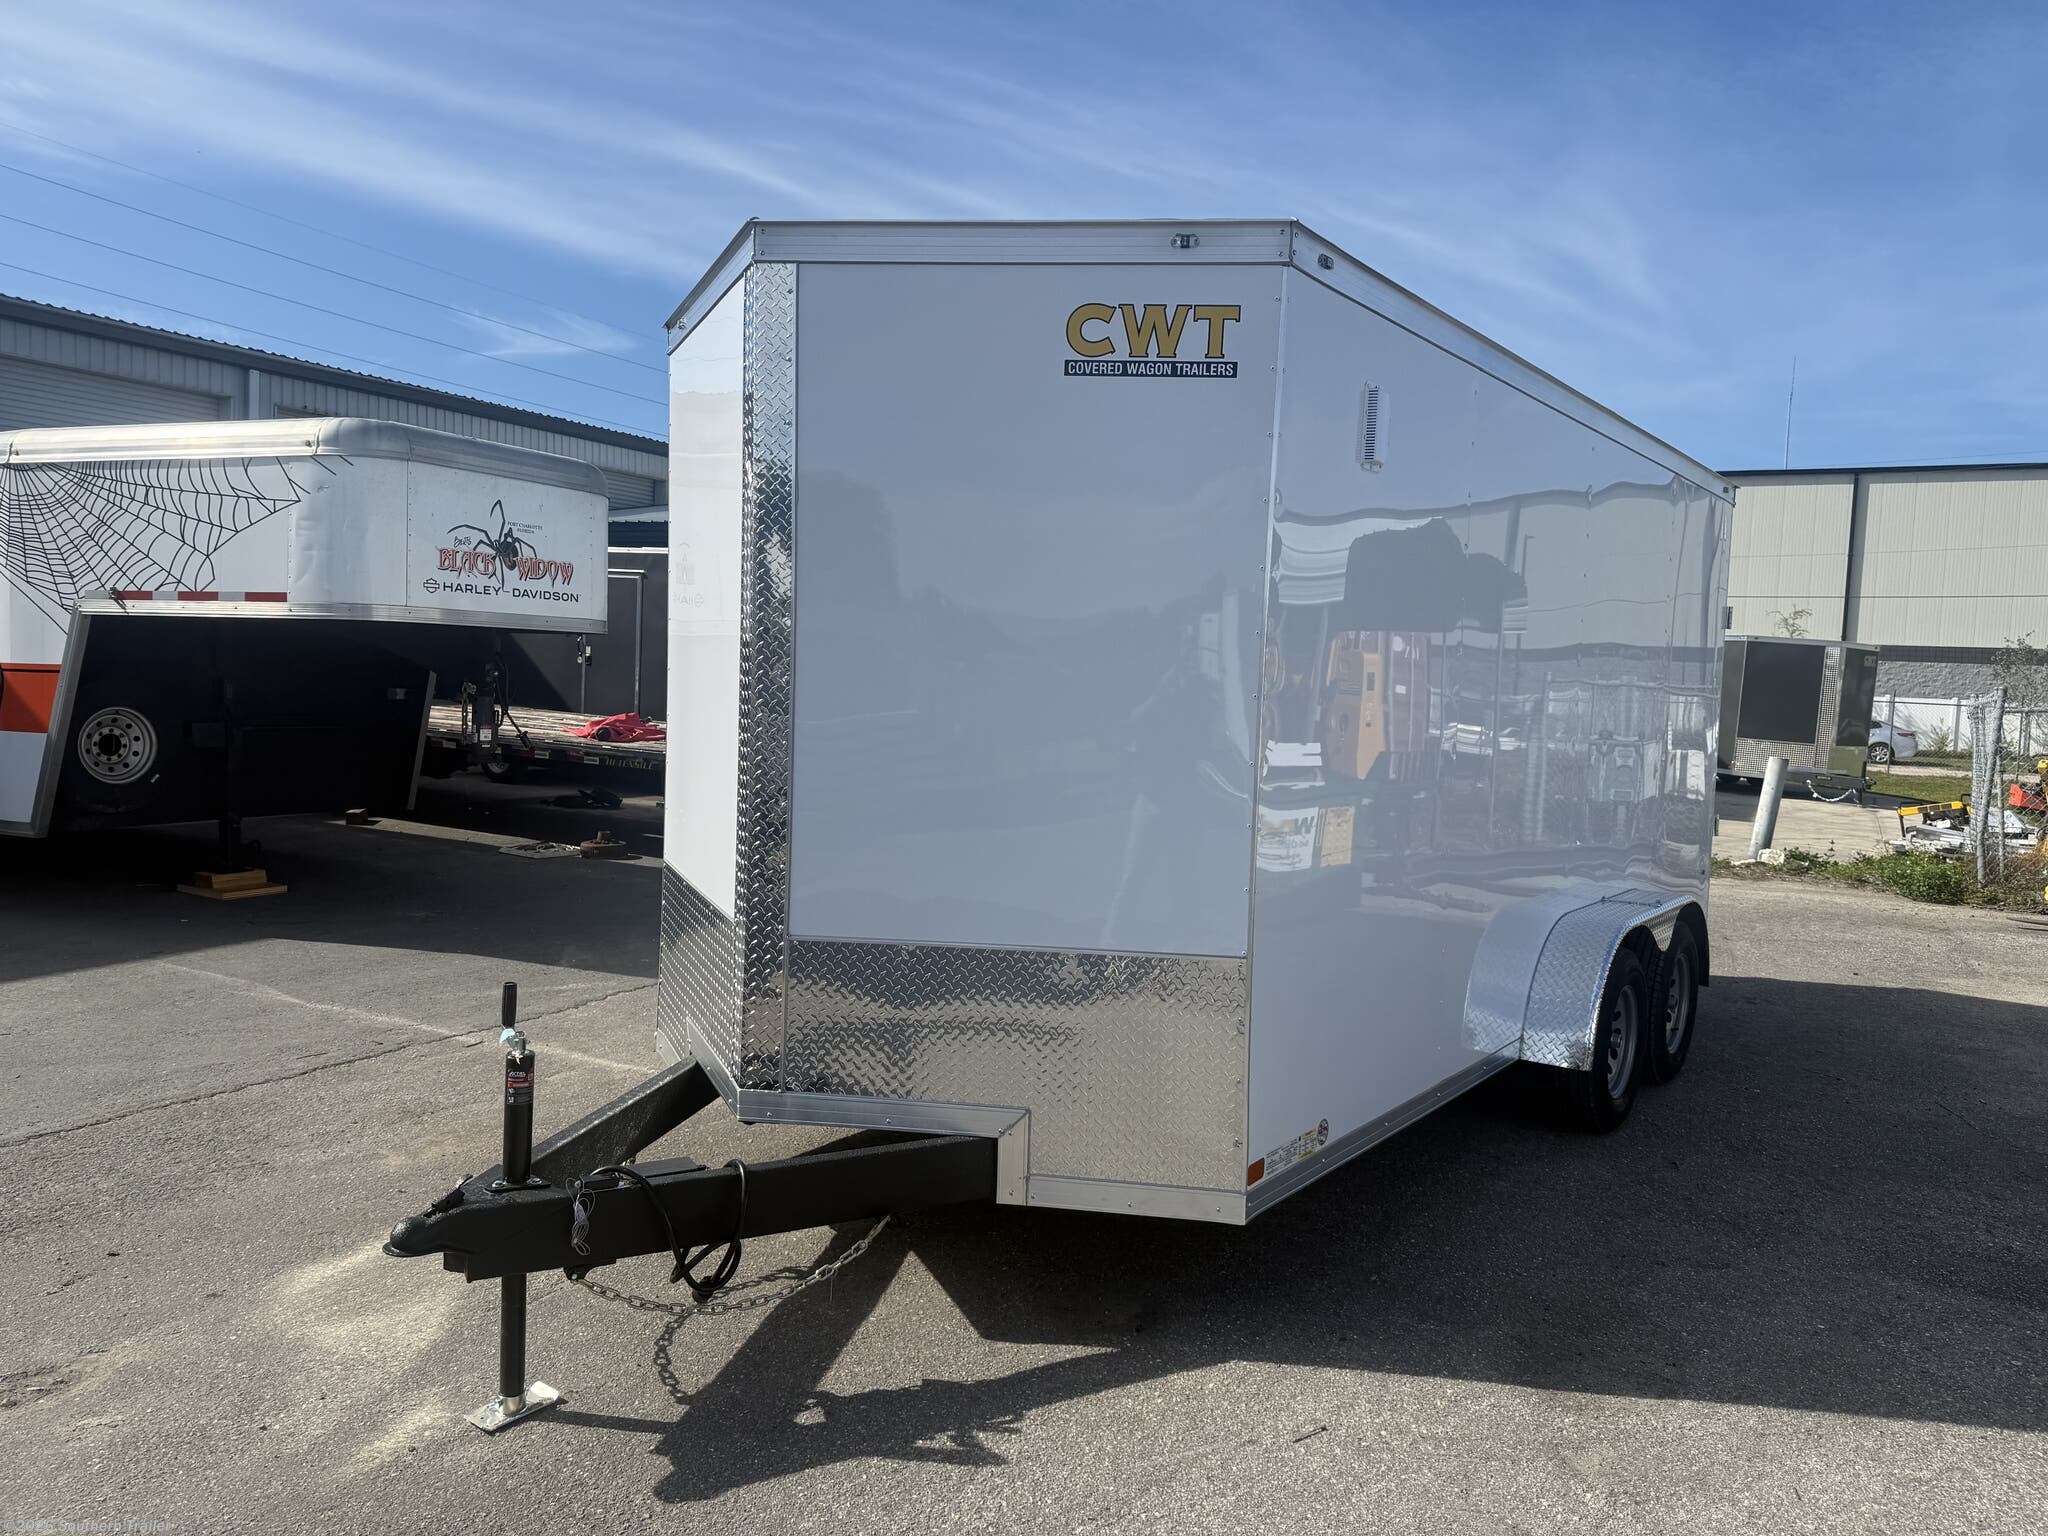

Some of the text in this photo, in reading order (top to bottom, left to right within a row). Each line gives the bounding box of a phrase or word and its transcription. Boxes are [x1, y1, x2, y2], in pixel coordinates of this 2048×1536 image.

[1066, 303, 1241, 358] CWT
[1068, 361, 1234, 377] COVERED WAGON TRAILERS
[438, 548, 574, 587] BLACK WIDOW
